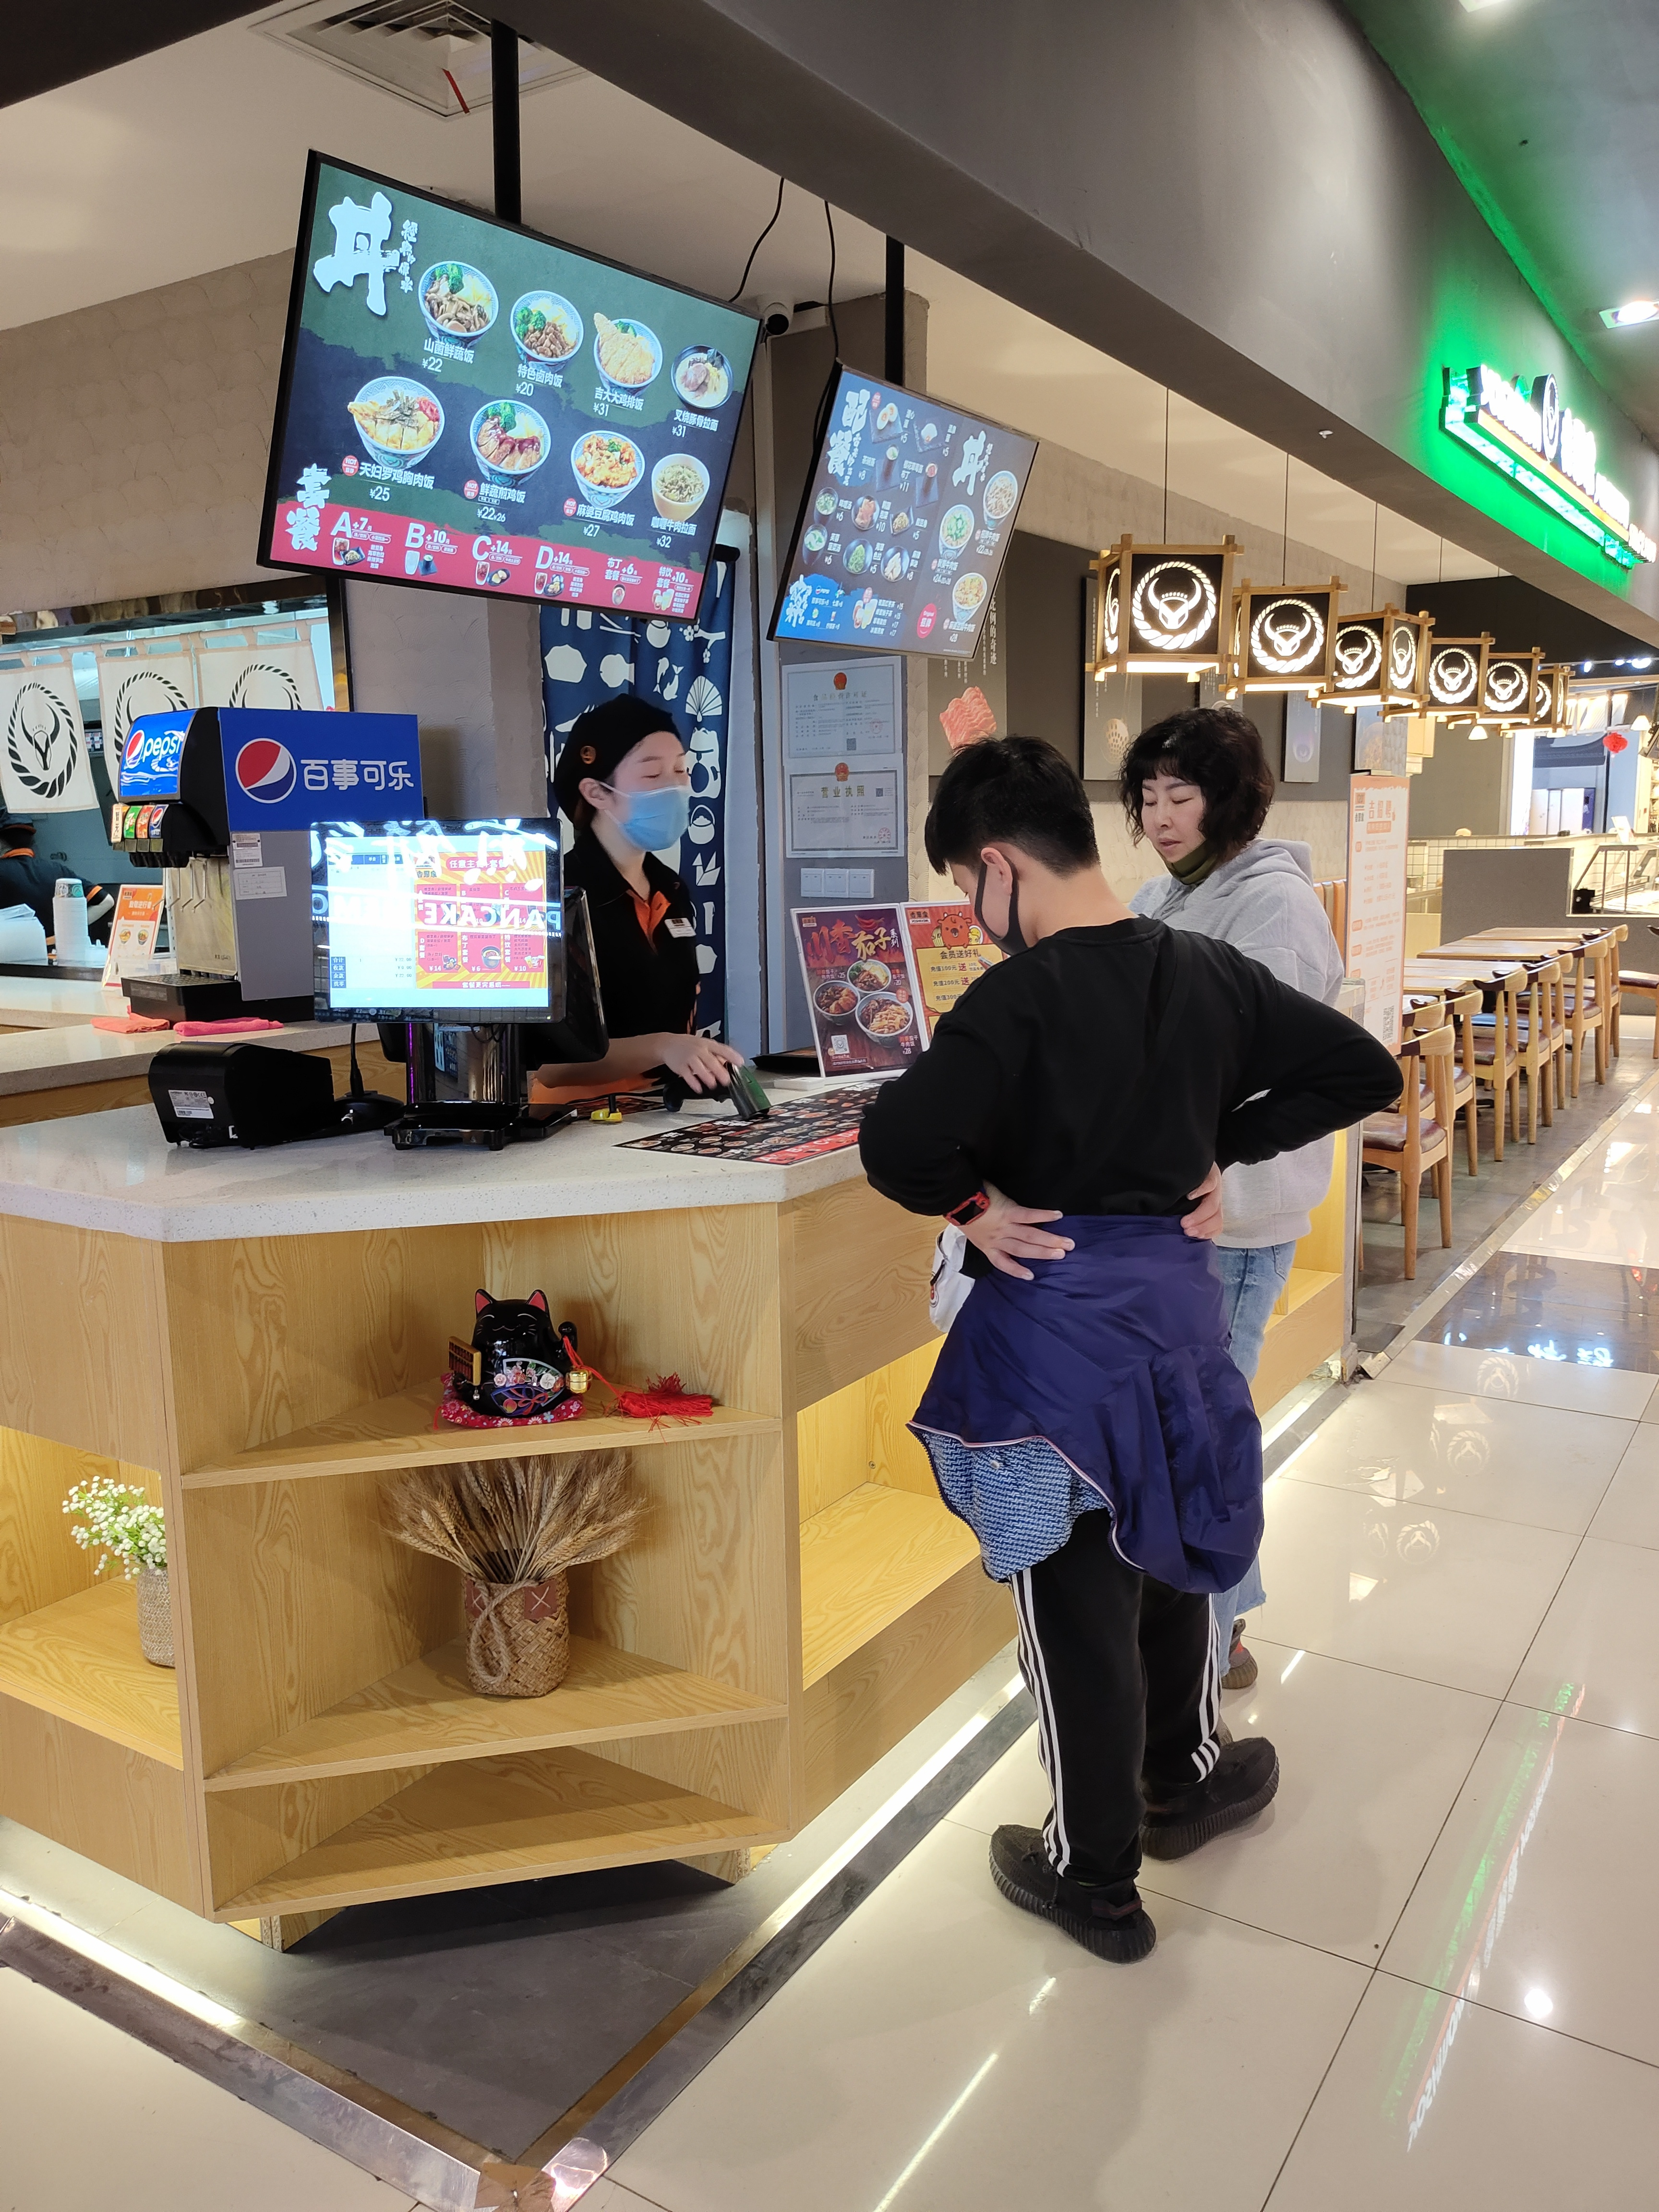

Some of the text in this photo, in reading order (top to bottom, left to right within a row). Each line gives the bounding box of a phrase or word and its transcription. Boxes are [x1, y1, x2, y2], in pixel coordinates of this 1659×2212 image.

[424, 338, 474, 363] 山菌鲜蔬饭
[422, 357, 443, 373] ¥22
[517, 364, 563, 388] 特色卤肉饭
[516, 382, 534, 397] ¥20
[595, 387, 644, 411] 吉大大鸡排饭
[593, 403, 609, 417] ¥31
[674, 409, 719, 432] 叉烧豚骨拉面
[673, 424, 686, 437] ¥31
[360, 462, 435, 490] 天妇罗鸡胸肉饭
[370, 486, 390, 502] ¥25
[330, 511, 352, 538] A
[583, 524, 600, 537] ¥27
[405, 522, 426, 548] B
[657, 536, 672, 548] ¥32
[472, 535, 492, 561] C
[535, 546, 553, 569] D
[607, 557, 623, 569] 布丁
[301, 759, 414, 791] 百事可乐
[821, 785, 865, 798] 营业执照
[807, 919, 891, 963] 川香茄子
[890, 928, 899, 948] 系列
[940, 949, 981, 960] 会员送好礼
[958, 962, 967, 971] 送
[961, 977, 970, 986] 送
